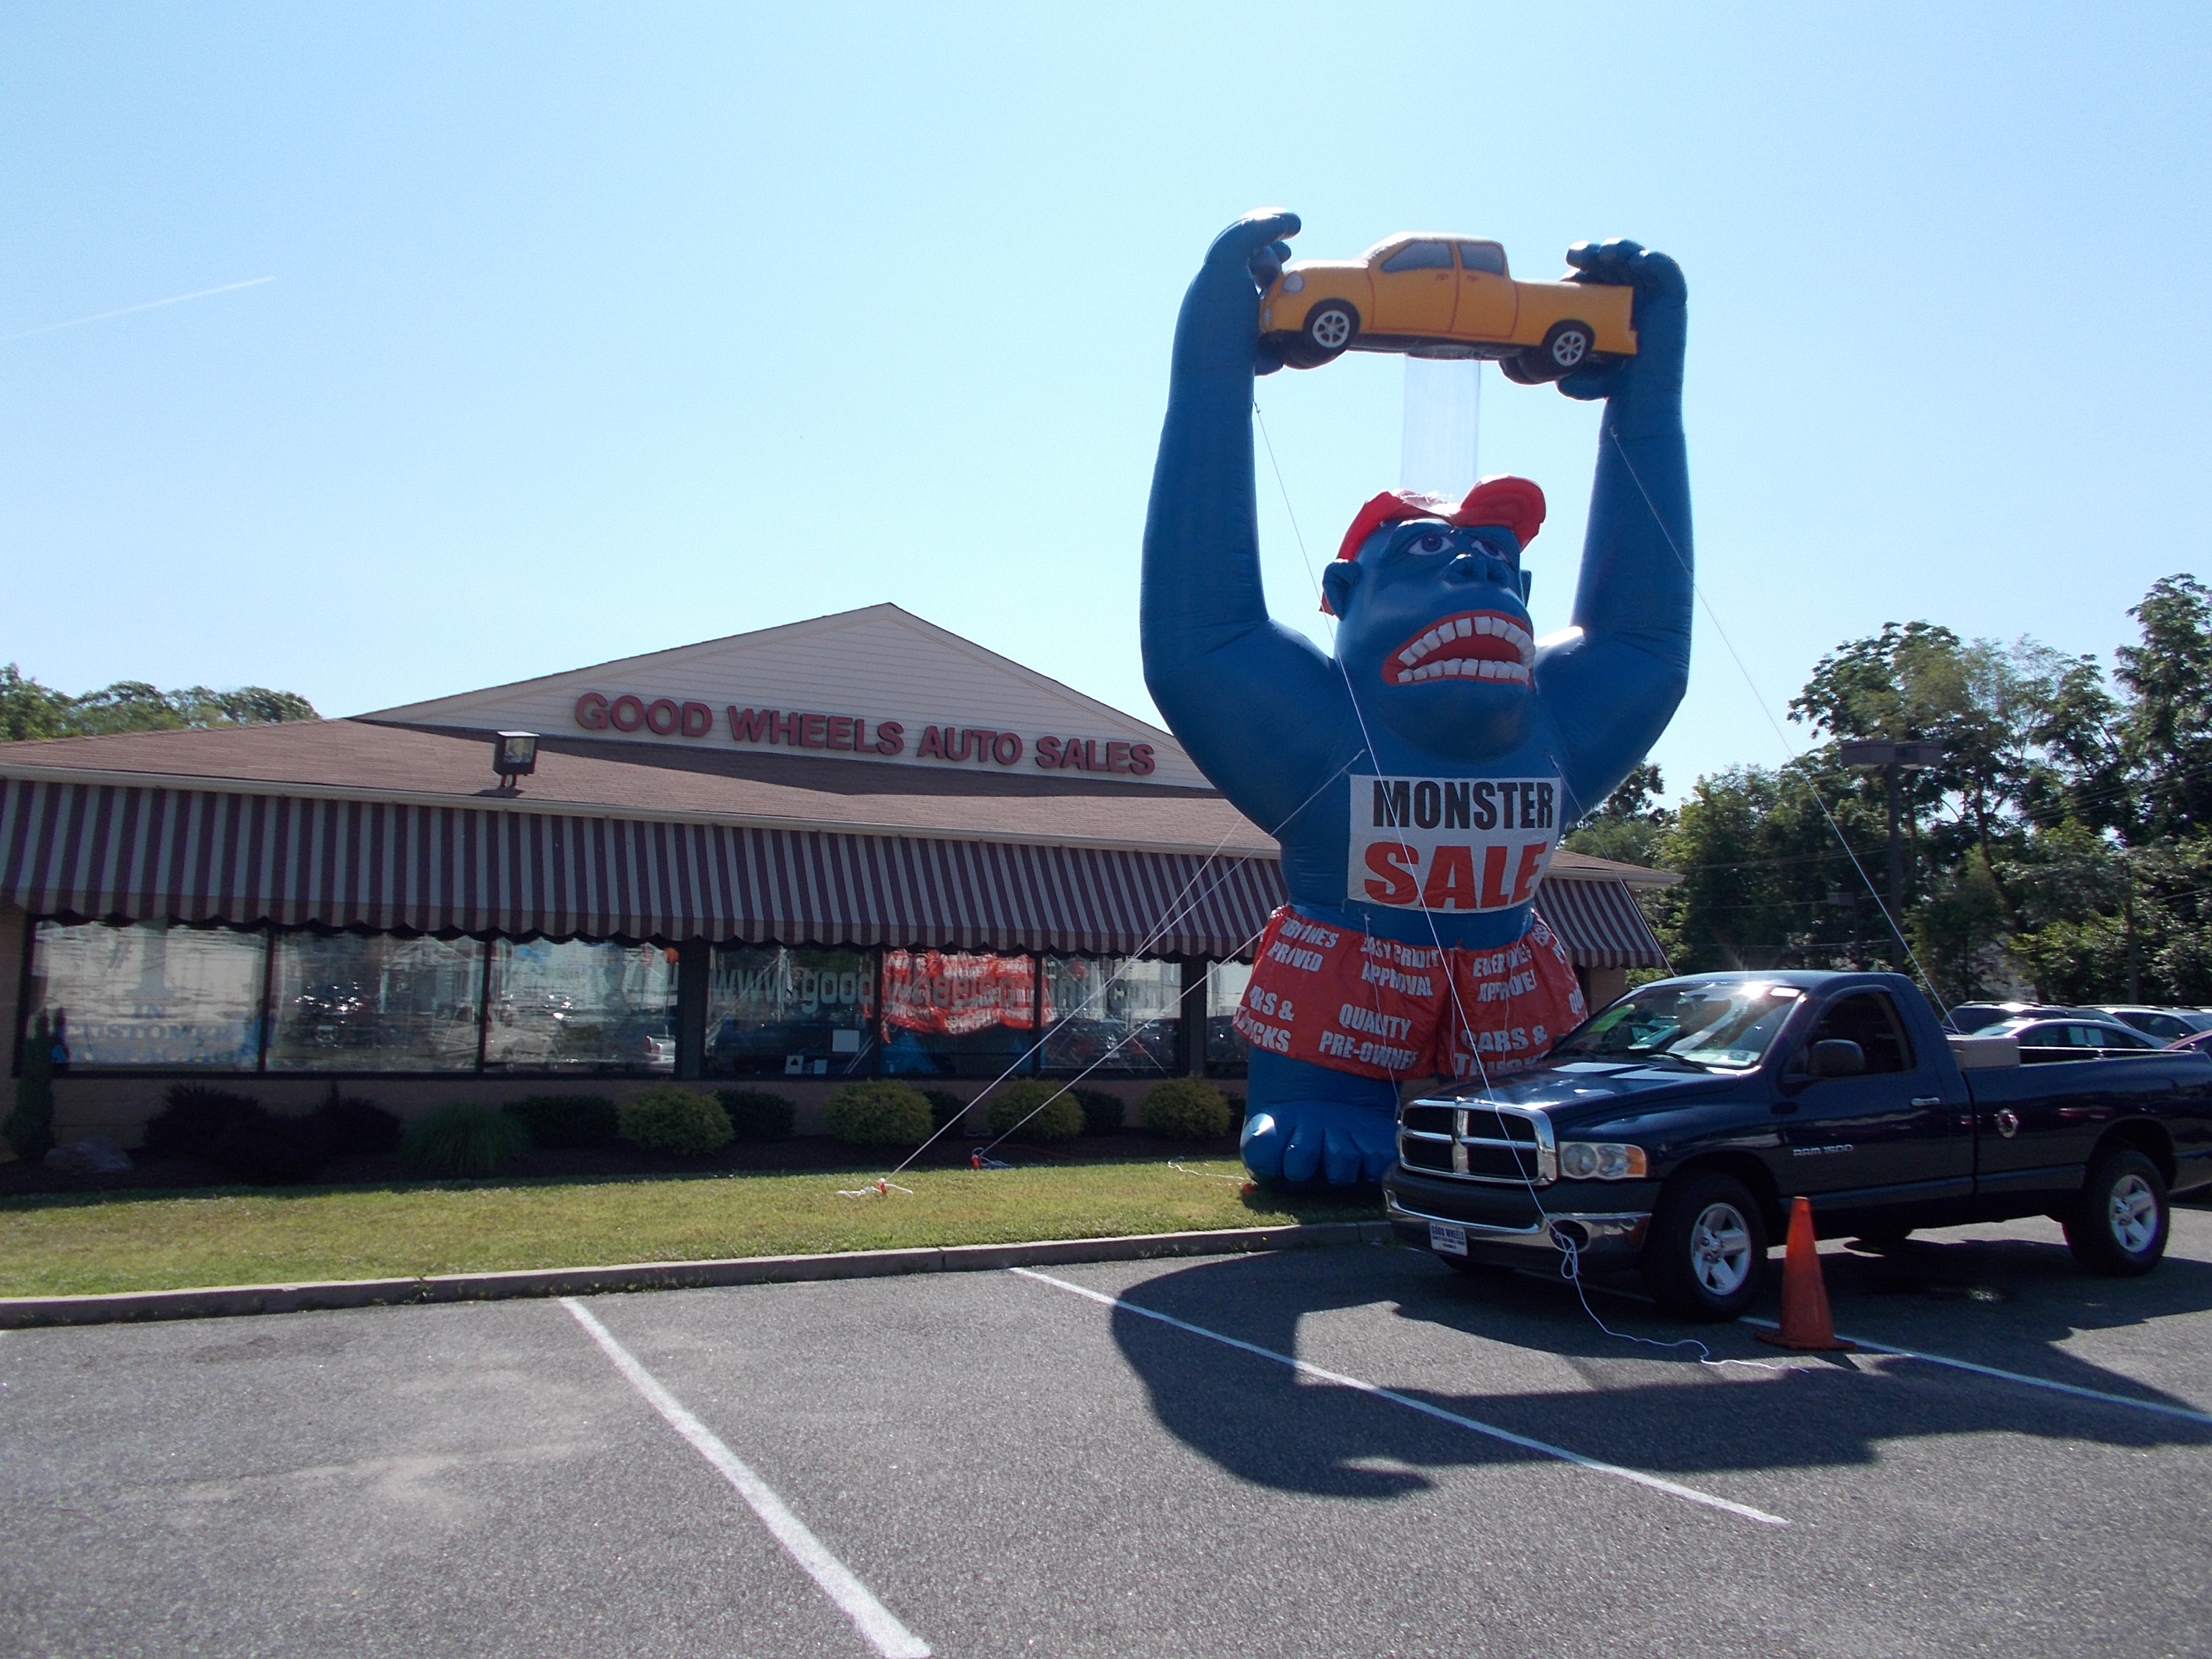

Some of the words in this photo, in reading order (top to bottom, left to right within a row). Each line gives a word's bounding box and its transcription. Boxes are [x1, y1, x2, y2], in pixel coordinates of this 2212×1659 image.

[575, 692, 712, 737] GOOD
[727, 705, 905, 756] WHEELS
[917, 724, 1023, 766] AUTO
[1035, 735, 1156, 776] SALES
[1373, 780, 1553, 830] MONSTER
[1364, 841, 1548, 909] SALE
[1338, 1003, 1412, 1041] QUALITY
[1460, 1027, 1529, 1052] CARS
[1532, 1025, 1548, 1046] &
